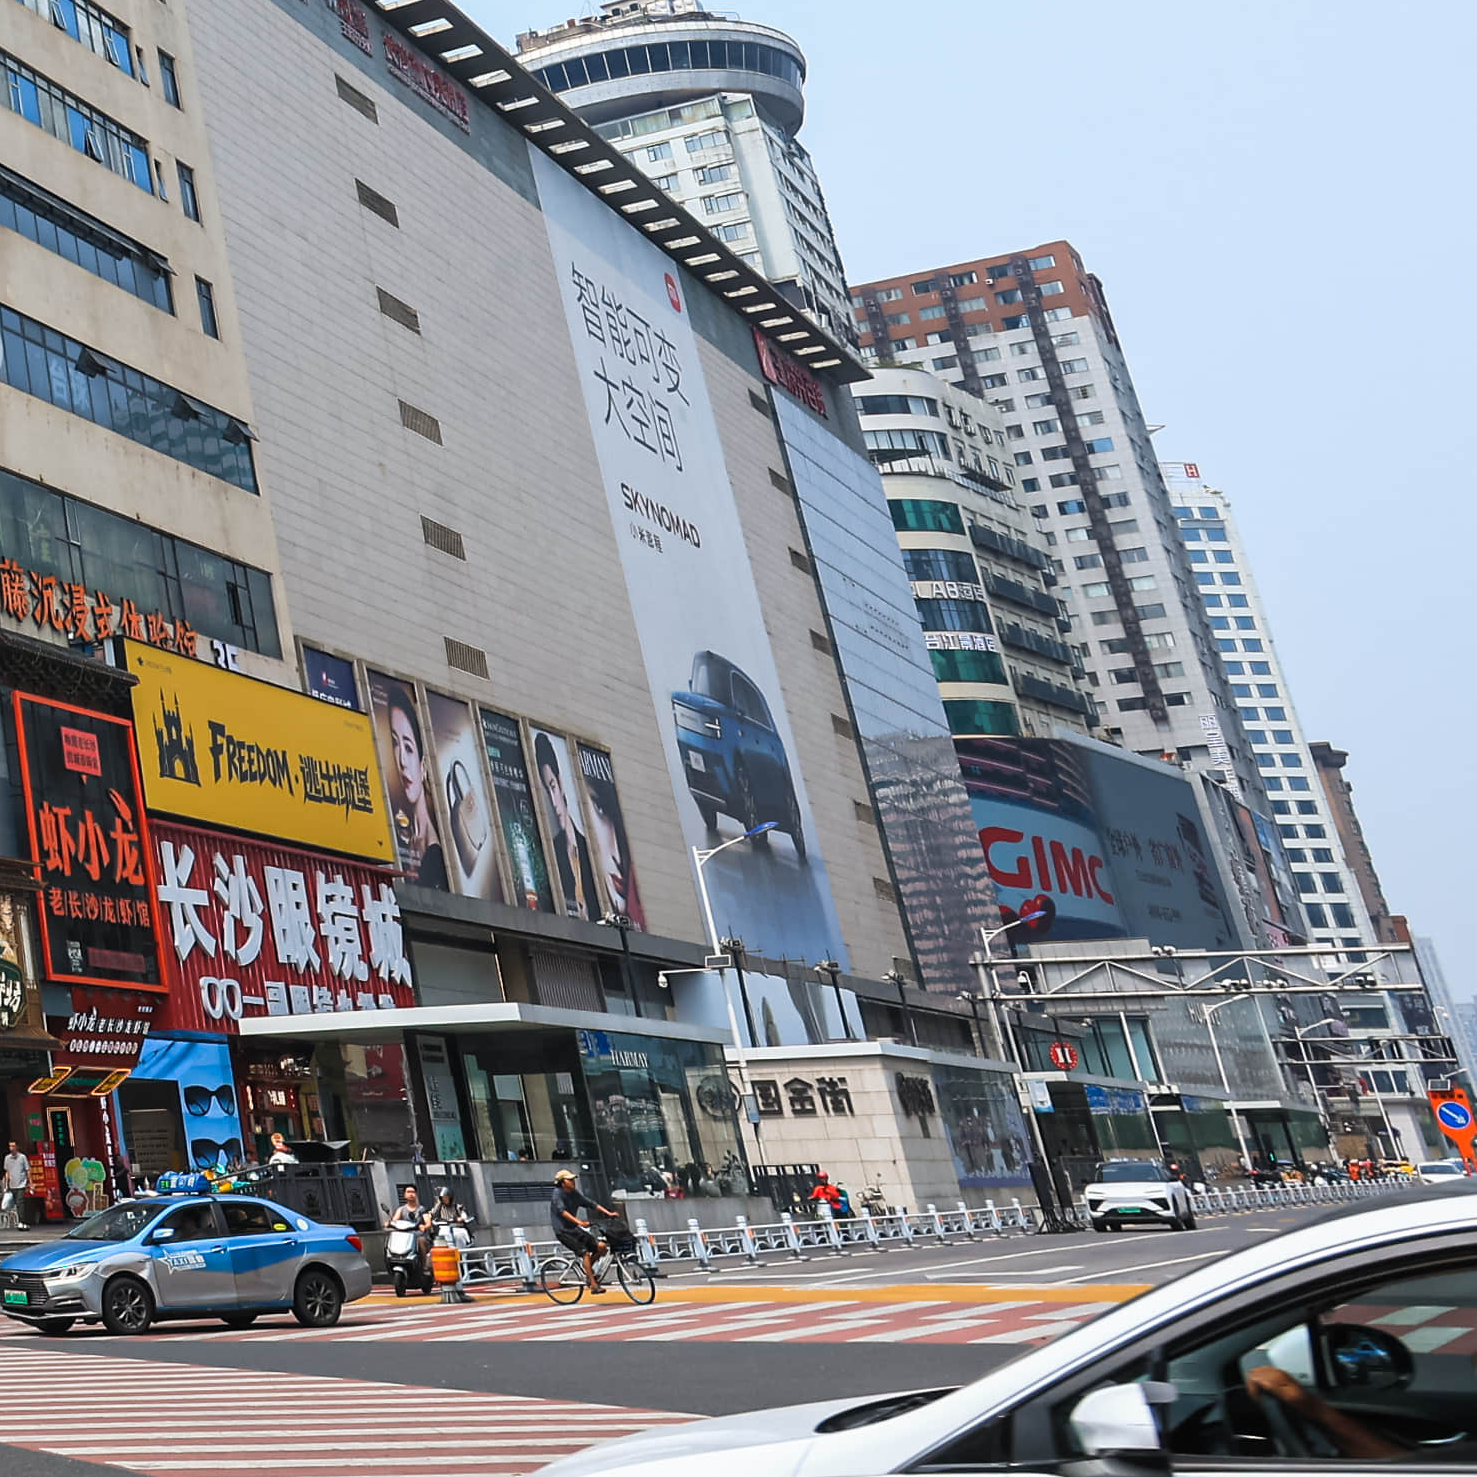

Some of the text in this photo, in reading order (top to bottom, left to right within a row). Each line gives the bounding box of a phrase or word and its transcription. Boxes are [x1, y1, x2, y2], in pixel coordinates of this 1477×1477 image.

[571, 261, 690, 406] 智能可变
[594, 356, 683, 472] 大空间
[620, 482, 700, 548] SKYNOMAD
[208, 720, 294, 797] FREEDOM
[38, 788, 145, 885] 虾小龙
[978, 826, 1114, 905] GIMC
[157, 841, 412, 988] 长沙眼镜城
[68, 1006, 95, 1031] 虾小龙
[750, 1076, 855, 1116] 国金街
